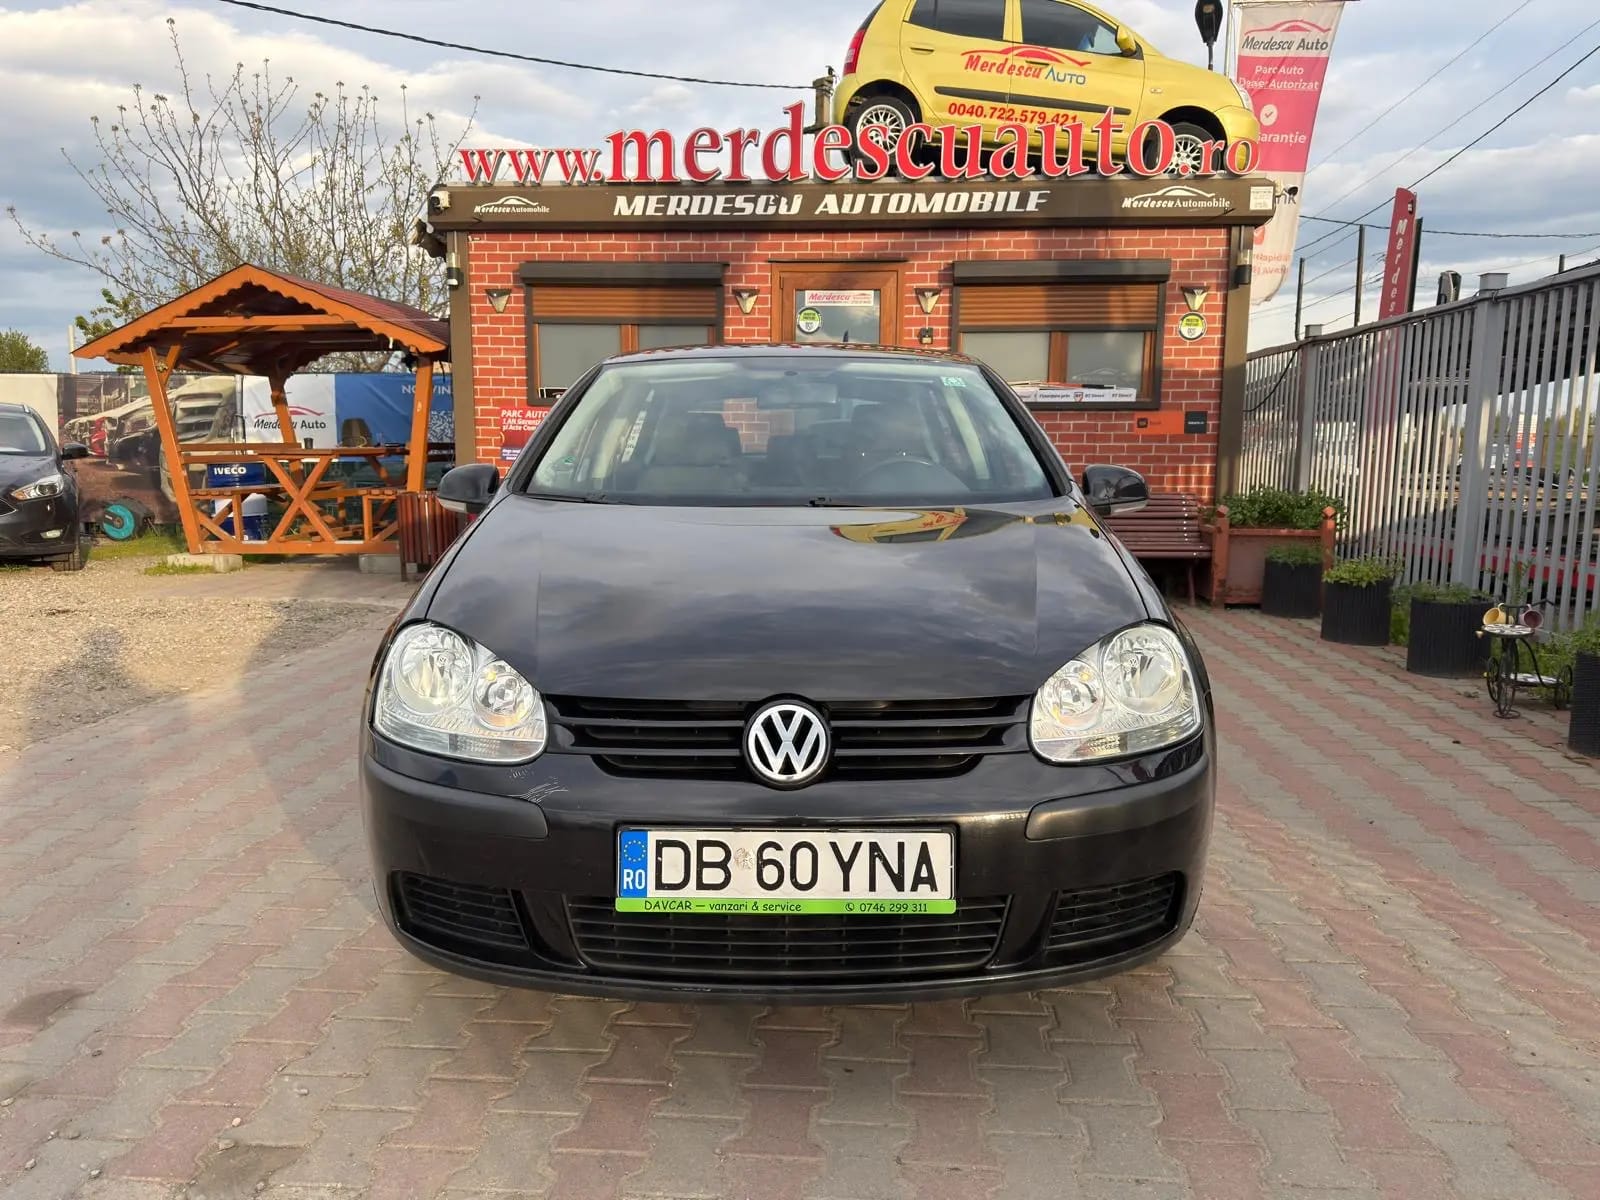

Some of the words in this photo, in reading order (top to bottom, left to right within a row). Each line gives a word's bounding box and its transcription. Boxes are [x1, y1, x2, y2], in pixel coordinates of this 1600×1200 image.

[1242, 36, 1294, 51] Merdescu
[1296, 38, 1329, 51] Auto
[964, 54, 1043, 79] Merdescu
[1255, 65, 1277, 75] Parc
[1278, 65, 1305, 75] Auto
[1268, 79, 1319, 91] Autorizat
[948, 102, 1078, 126] 0040.722.579.421
[458, 100, 1260, 186] www.merdescuauto.ro
[613, 194, 803, 216] MERDESCU
[815, 190, 1051, 215] AUTOMOBILE
[1388, 219, 1408, 319] Merdes
[525, 410, 549, 418] AUTO
[301, 420, 326, 430] Auto
[214, 467, 247, 475] IVECO
[750, 706, 823, 778] VW
[654, 839, 732, 891] DB
[756, 840, 819, 891] 60
[829, 841, 939, 892] YNA
[623, 868, 646, 890] RO
[644, 900, 692, 911] DAVCAR
[709, 901, 749, 911] vanzari
[751, 901, 760, 911] &
[762, 902, 802, 911] service
[860, 903, 886, 912] 0746
[889, 903, 909, 912] 299
[911, 903, 928, 912] 311
